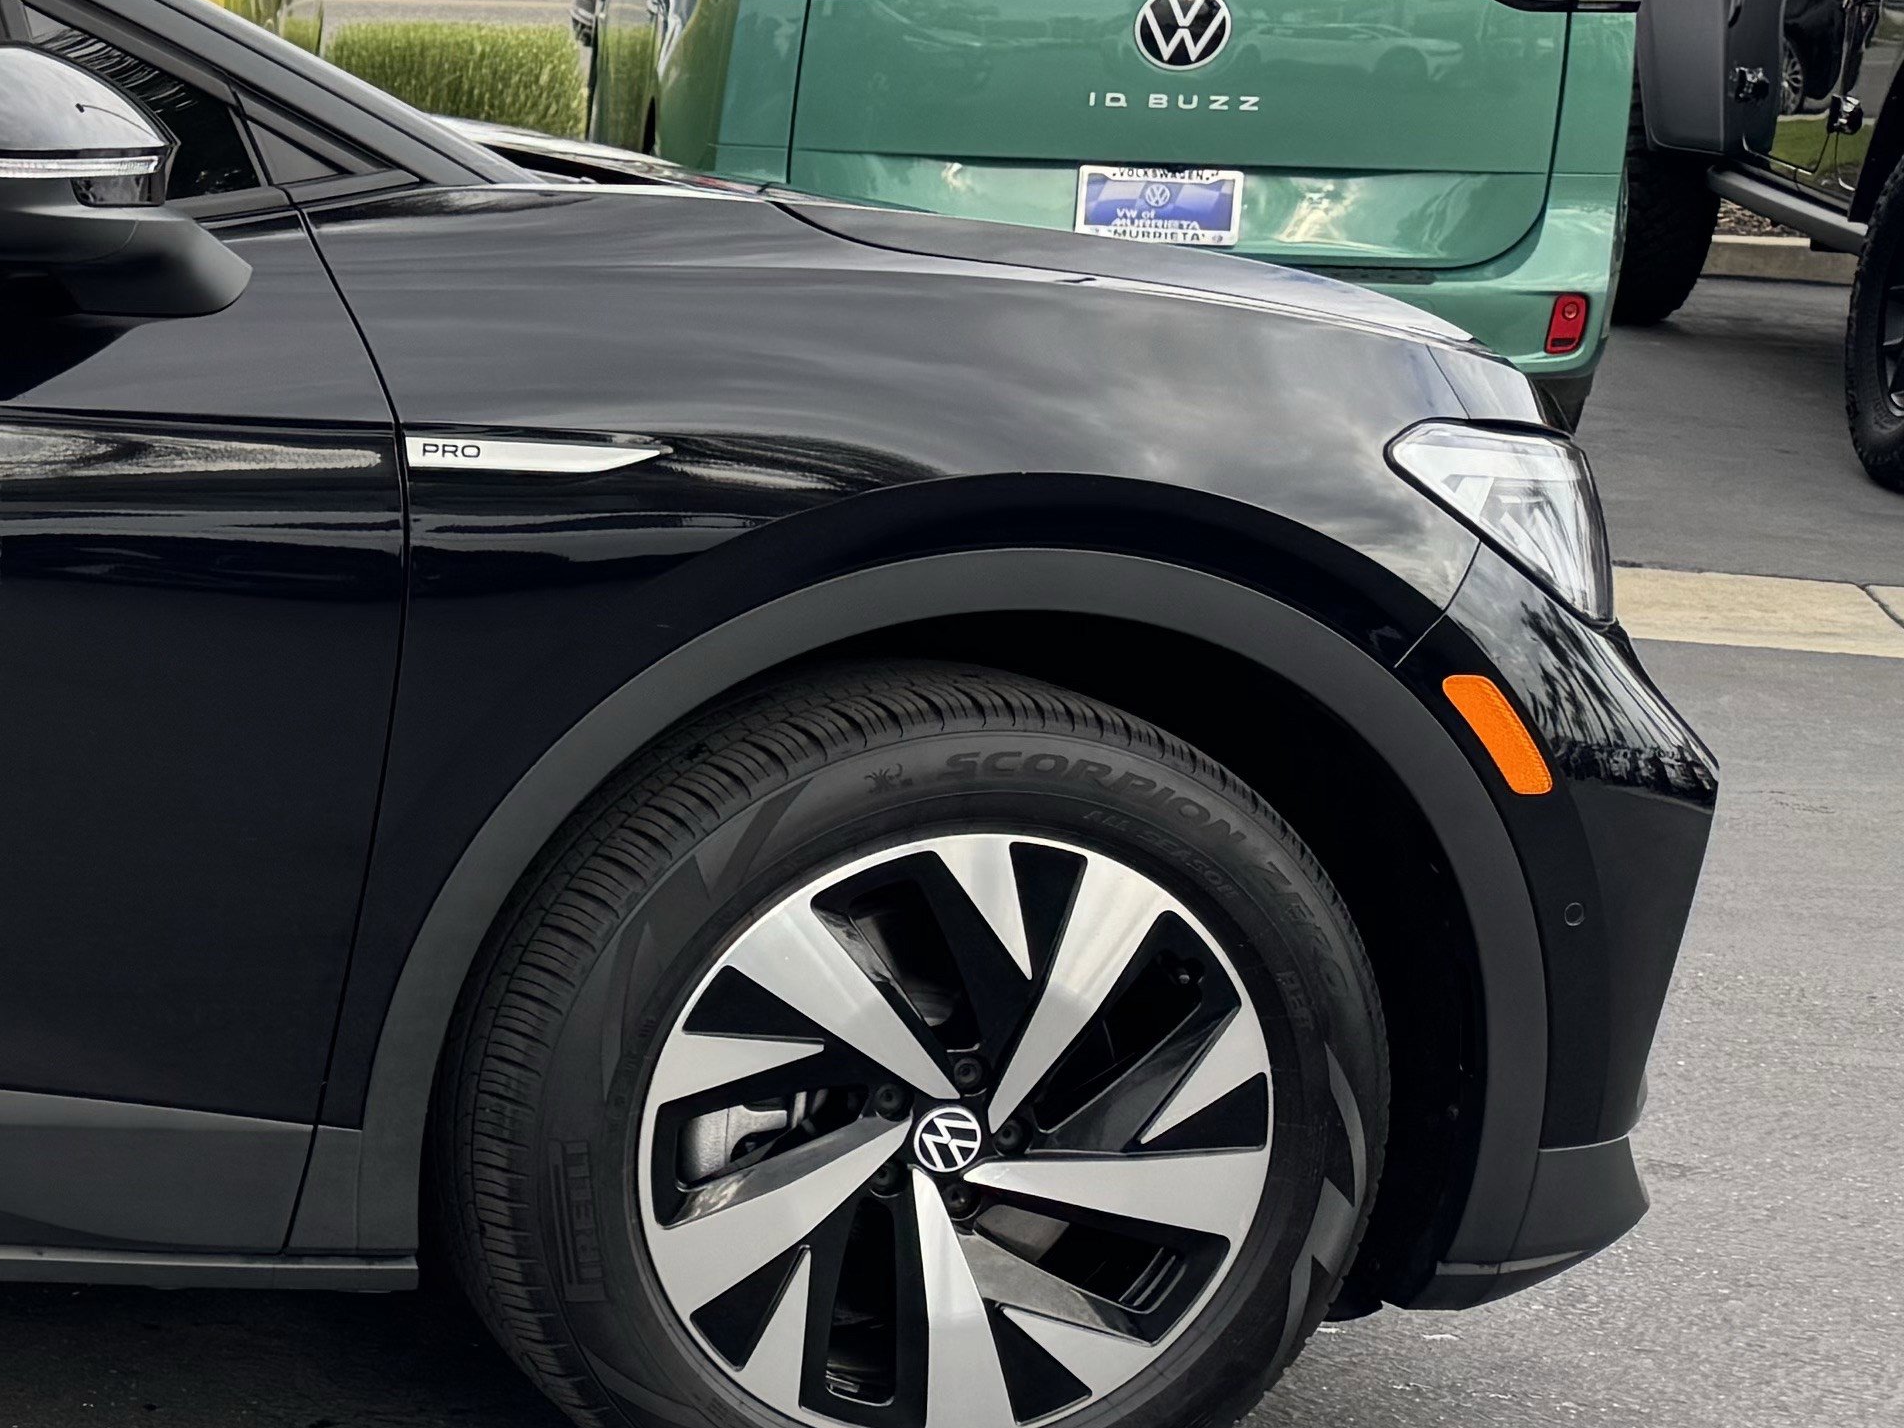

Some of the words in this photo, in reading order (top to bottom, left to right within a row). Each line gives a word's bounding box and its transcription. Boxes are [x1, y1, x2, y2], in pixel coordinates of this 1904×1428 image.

[1148, 93, 1261, 111] BUZZ
[1116, 208, 1137, 219] VW
[422, 442, 481, 459] PRO
[944, 750, 1246, 847] SCORPION
[550, 1139, 608, 1303] PIRELLI
